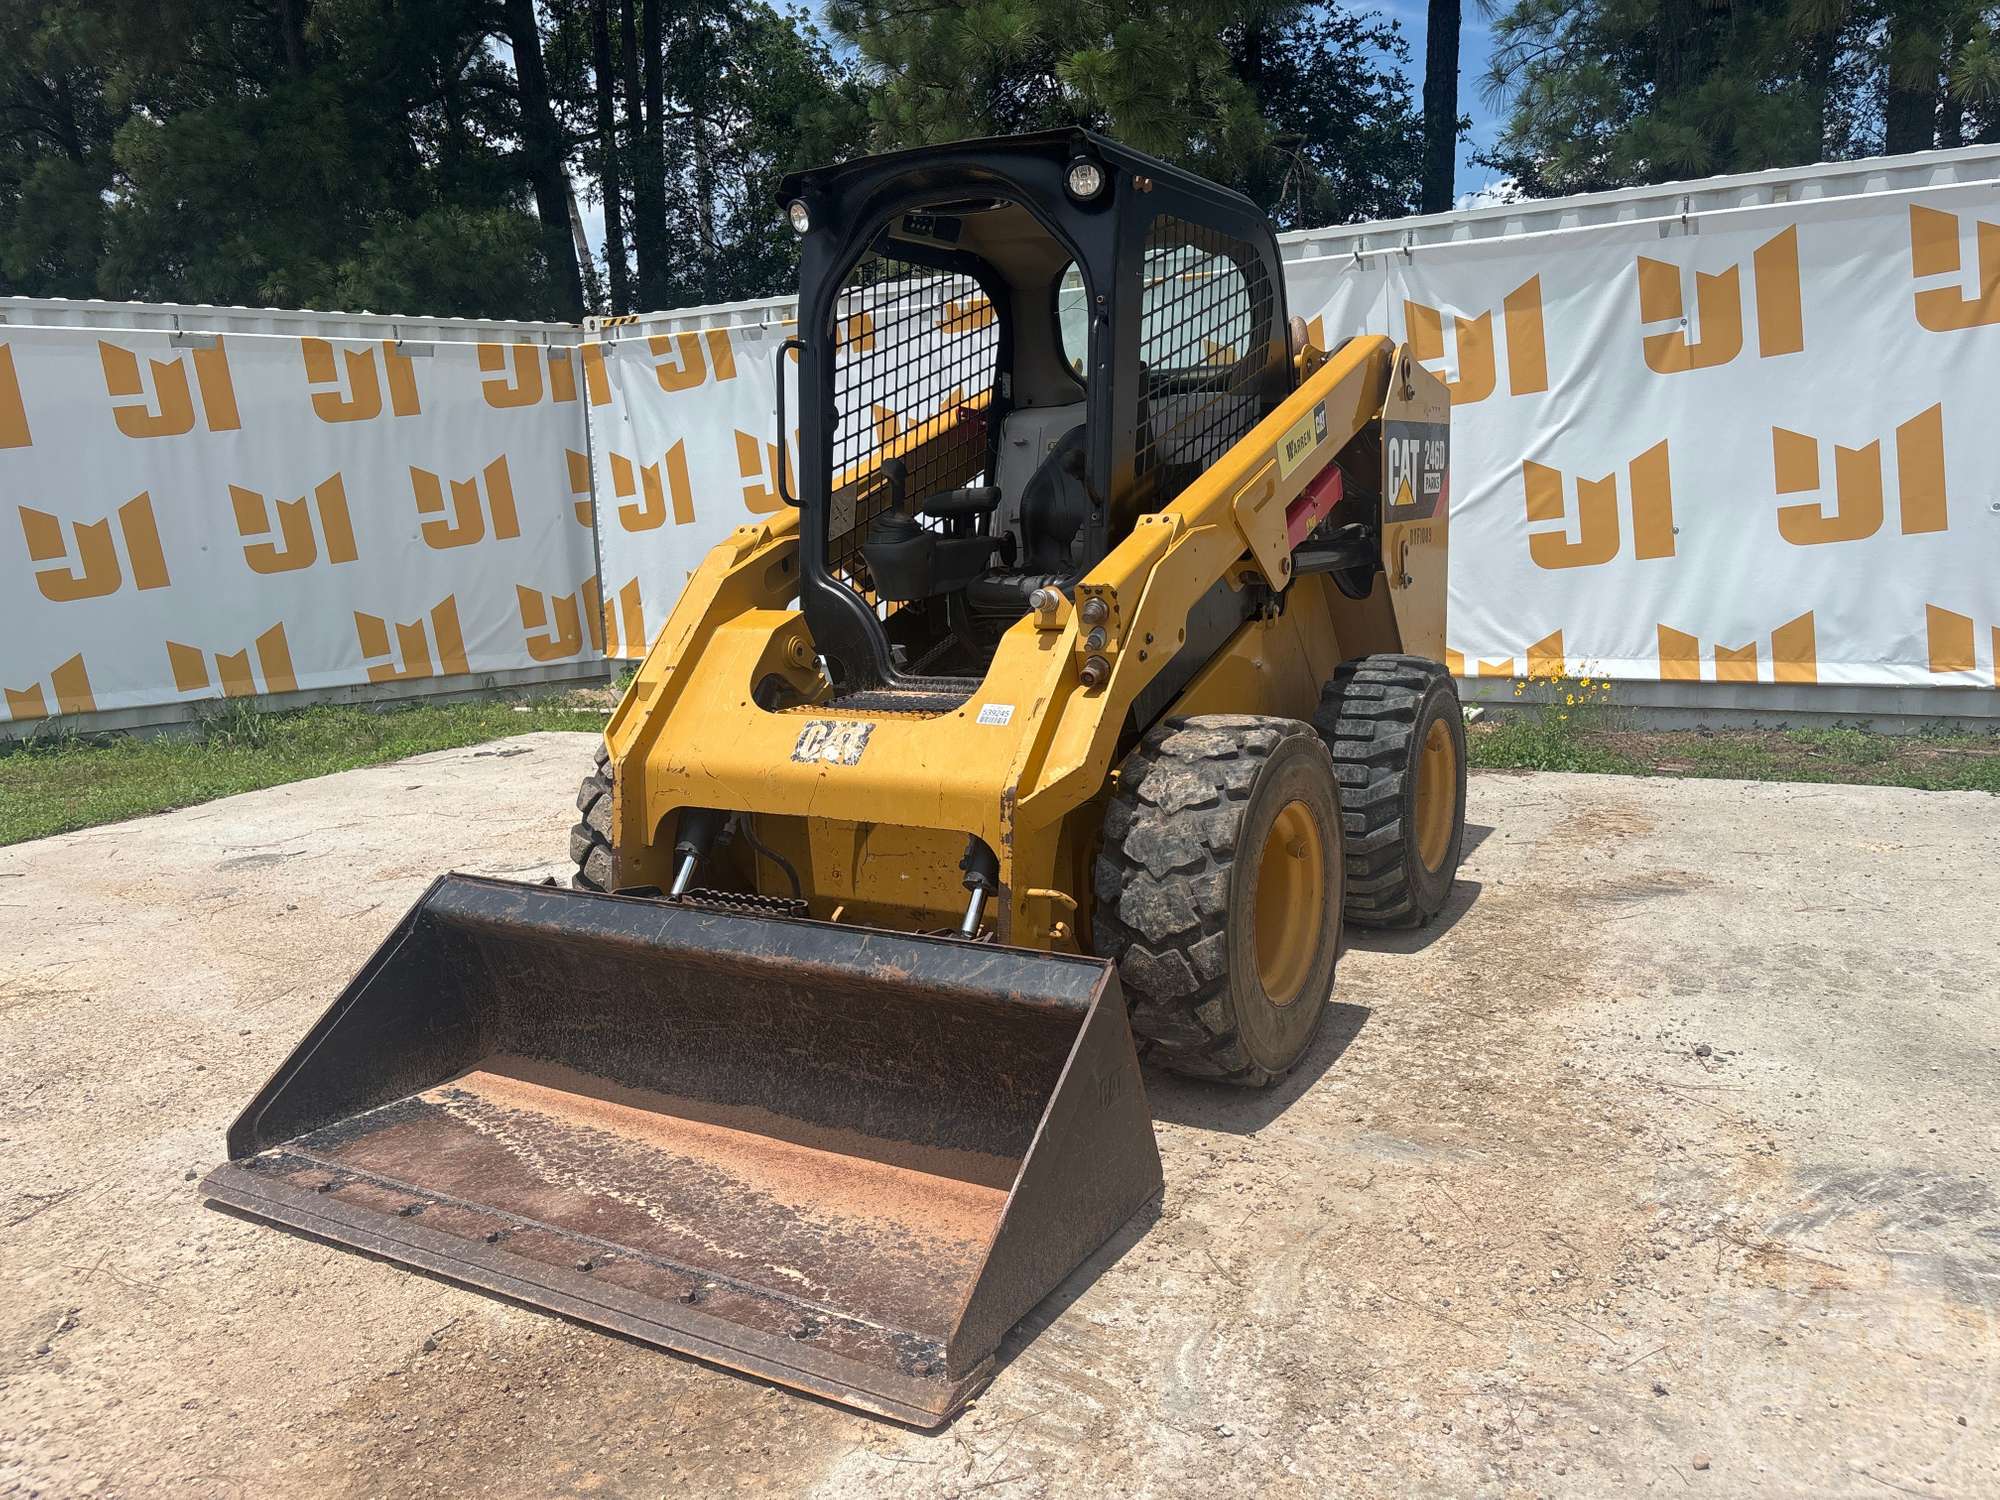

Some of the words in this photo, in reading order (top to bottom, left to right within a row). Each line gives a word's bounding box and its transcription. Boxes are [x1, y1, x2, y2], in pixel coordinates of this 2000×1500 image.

[1286, 428, 1311, 462] WARREN
[1424, 440, 1445, 471] 246D
[1388, 437, 1420, 506] CAT
